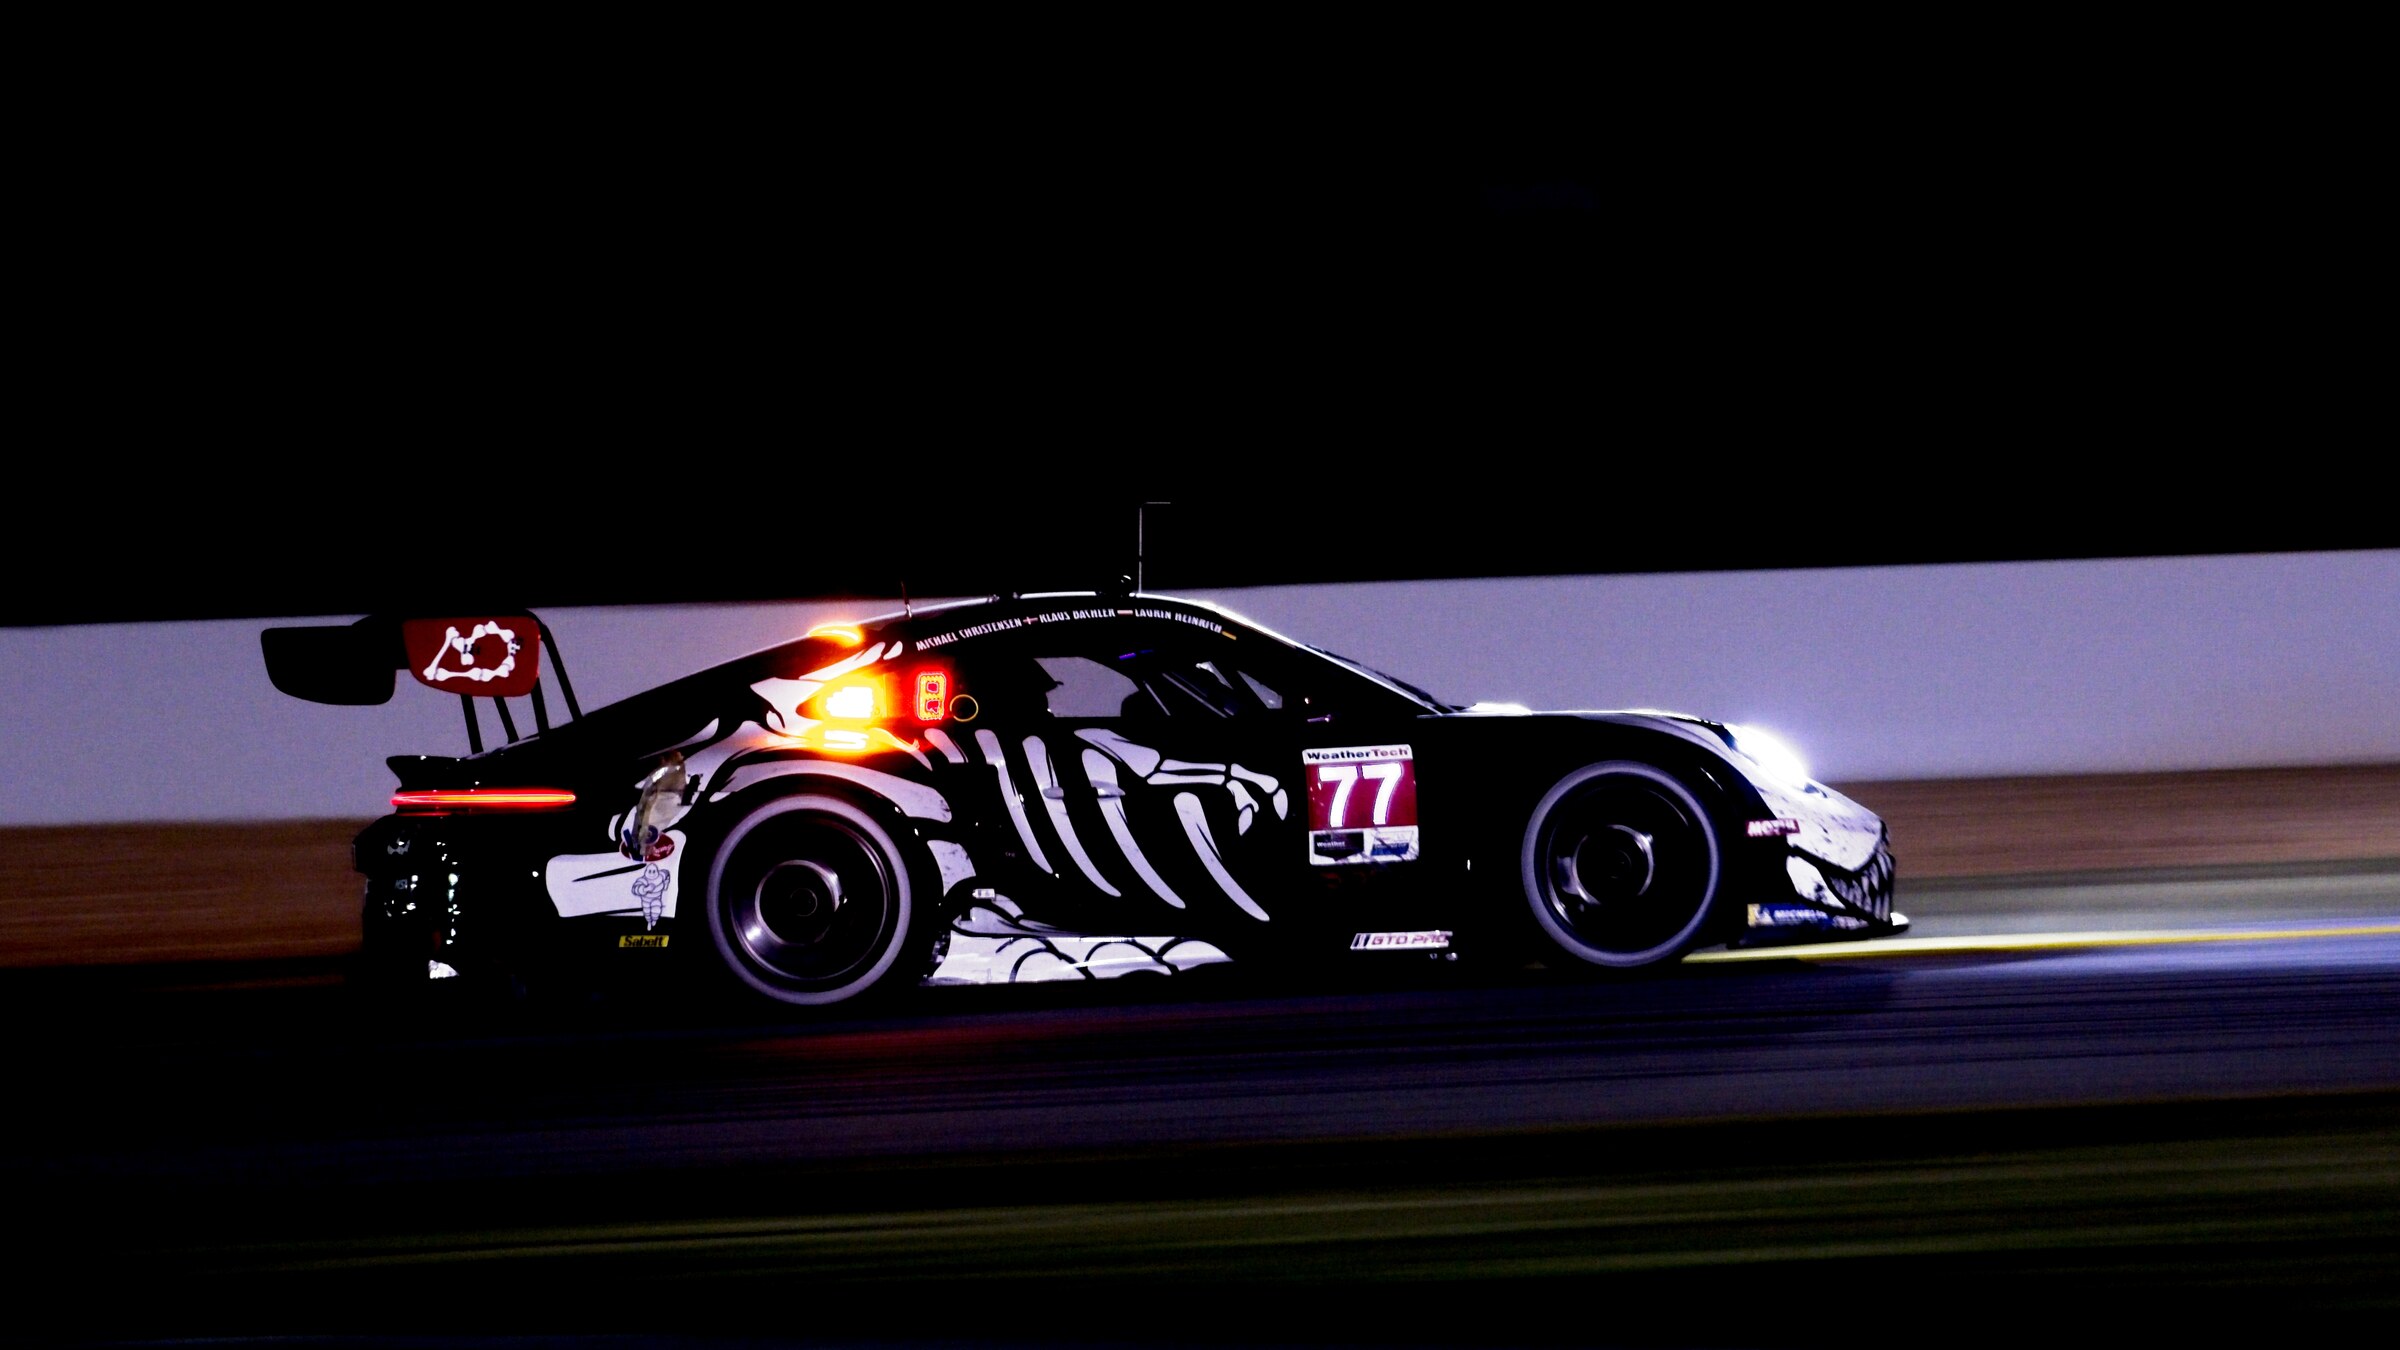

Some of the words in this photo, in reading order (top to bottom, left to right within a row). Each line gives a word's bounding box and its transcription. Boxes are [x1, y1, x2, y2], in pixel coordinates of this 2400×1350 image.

[1039, 612, 1071, 624] KLAUS
[1135, 608, 1172, 620] LAURIN
[1174, 612, 1222, 634] HEINRICH
[916, 631, 960, 651] MICHAEL
[959, 616, 1023, 639] CHRISTENSEN
[1307, 748, 1409, 761] WeatherTech
[1318, 762, 1402, 828] 77
[623, 935, 665, 948] Sabelt
